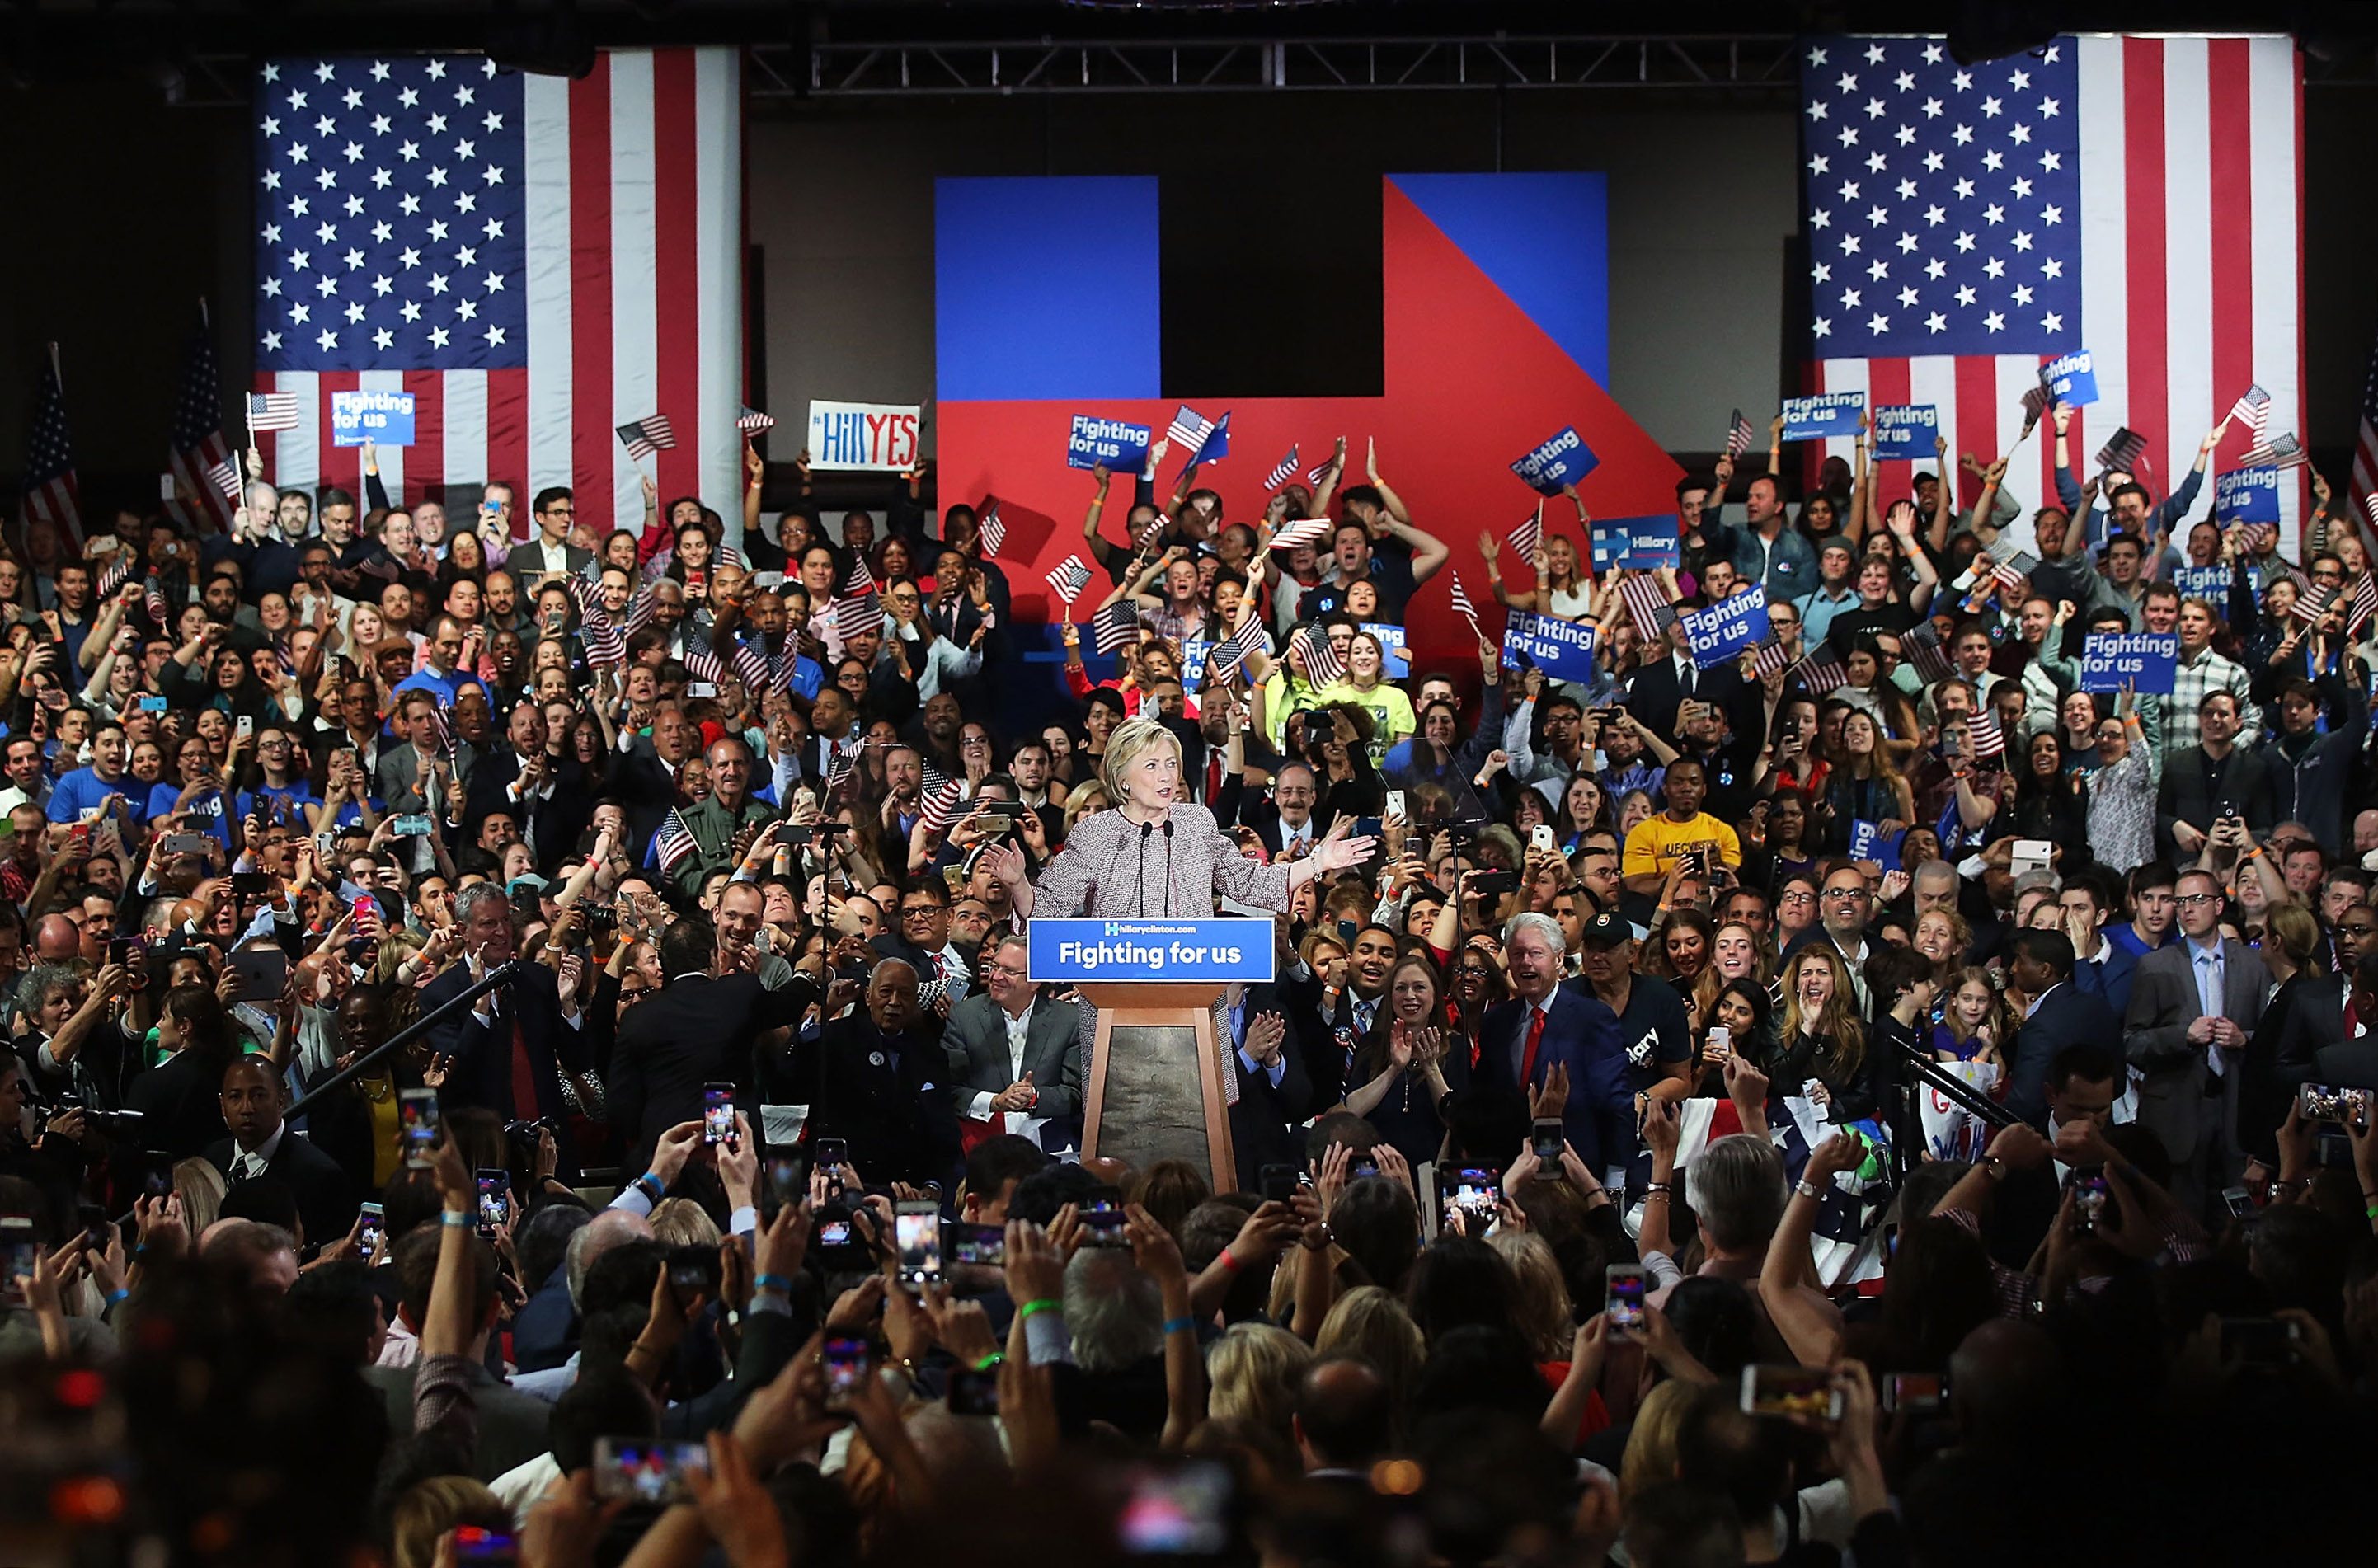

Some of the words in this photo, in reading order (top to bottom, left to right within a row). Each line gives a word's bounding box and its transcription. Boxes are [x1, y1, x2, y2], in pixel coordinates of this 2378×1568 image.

[2053, 378, 2072, 396] us
[332, 392, 414, 415] Fighting
[1783, 393, 1863, 413] Fighting
[333, 411, 361, 429] for
[363, 413, 387, 428] us
[1782, 411, 1810, 424] for
[1813, 408, 1836, 422] us
[1875, 406, 1936, 428] Fighting
[1072, 415, 1150, 447] Fighting
[1892, 428, 1912, 443] us
[1069, 433, 1096, 453] for
[1096, 439, 1120, 458] us
[1511, 430, 1580, 475] Fighting
[1544, 461, 1567, 480] us
[2216, 467, 2277, 495] Fighting
[2232, 491, 2251, 508] us
[1633, 535, 1675, 552] Hillary
[1682, 587, 1765, 636] Fighting
[1507, 609, 1593, 650] Fighting
[1688, 631, 1721, 654] for
[1722, 620, 1749, 641] us
[1504, 628, 1534, 653] for
[1534, 641, 1561, 660] us
[2084, 633, 2176, 659] Fighting
[2082, 653, 2115, 673] for
[2117, 658, 2144, 673] us
[1119, 924, 1196, 936] hillaryclinton.com
[1060, 941, 1165, 969] Fighting
[1169, 941, 1207, 964] for
[1211, 946, 1242, 964] us
